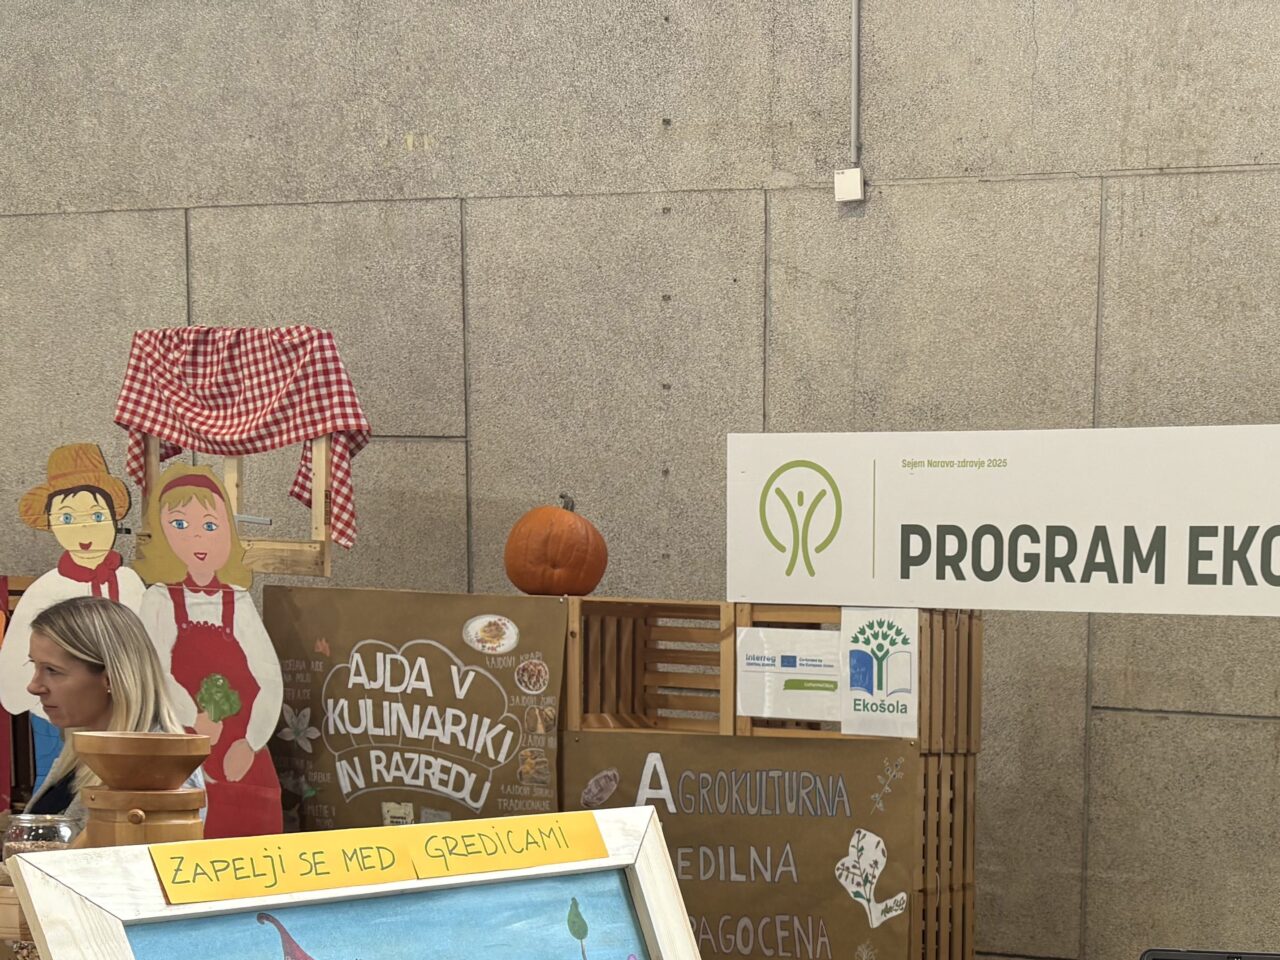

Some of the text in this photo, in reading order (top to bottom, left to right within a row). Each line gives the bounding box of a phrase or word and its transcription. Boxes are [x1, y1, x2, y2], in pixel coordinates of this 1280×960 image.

[901, 458, 926, 471] Sejem
[899, 523, 1168, 586] PROGRAM
[347, 652, 476, 700] AJDA V
[853, 698, 908, 715] Ekošola
[326, 698, 514, 764] KULINARIKI
[335, 749, 491, 810] IN RAZREDU
[635, 752, 851, 817] AGROKULTURNA
[299, 850, 331, 876] SE
[342, 846, 397, 874] MED
[676, 842, 799, 884] EDILNA
[689, 914, 833, 960] AGOCENA
